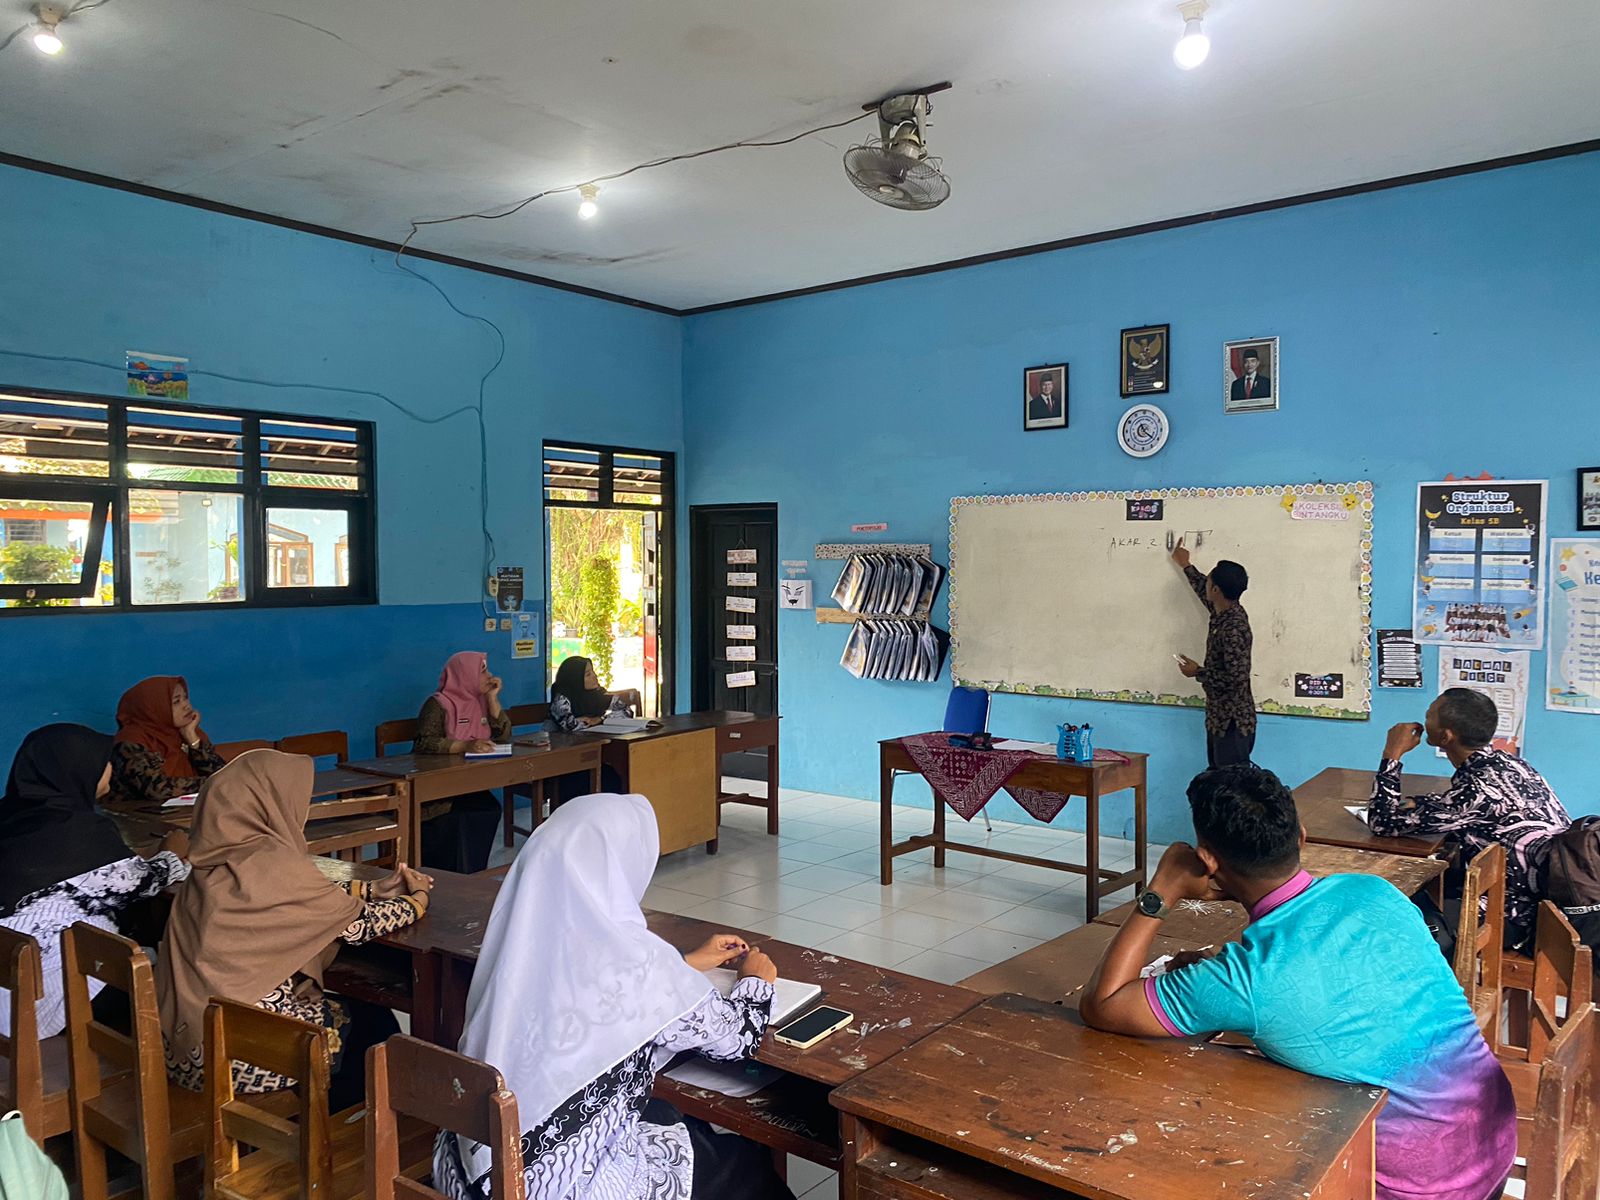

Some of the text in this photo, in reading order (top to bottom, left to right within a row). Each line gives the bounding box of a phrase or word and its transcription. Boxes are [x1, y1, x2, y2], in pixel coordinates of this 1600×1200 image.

[1452, 490, 1509, 502] Struktur
[1446, 501, 1514, 515] Organisasi
[1460, 517, 1485, 525] Kelas
